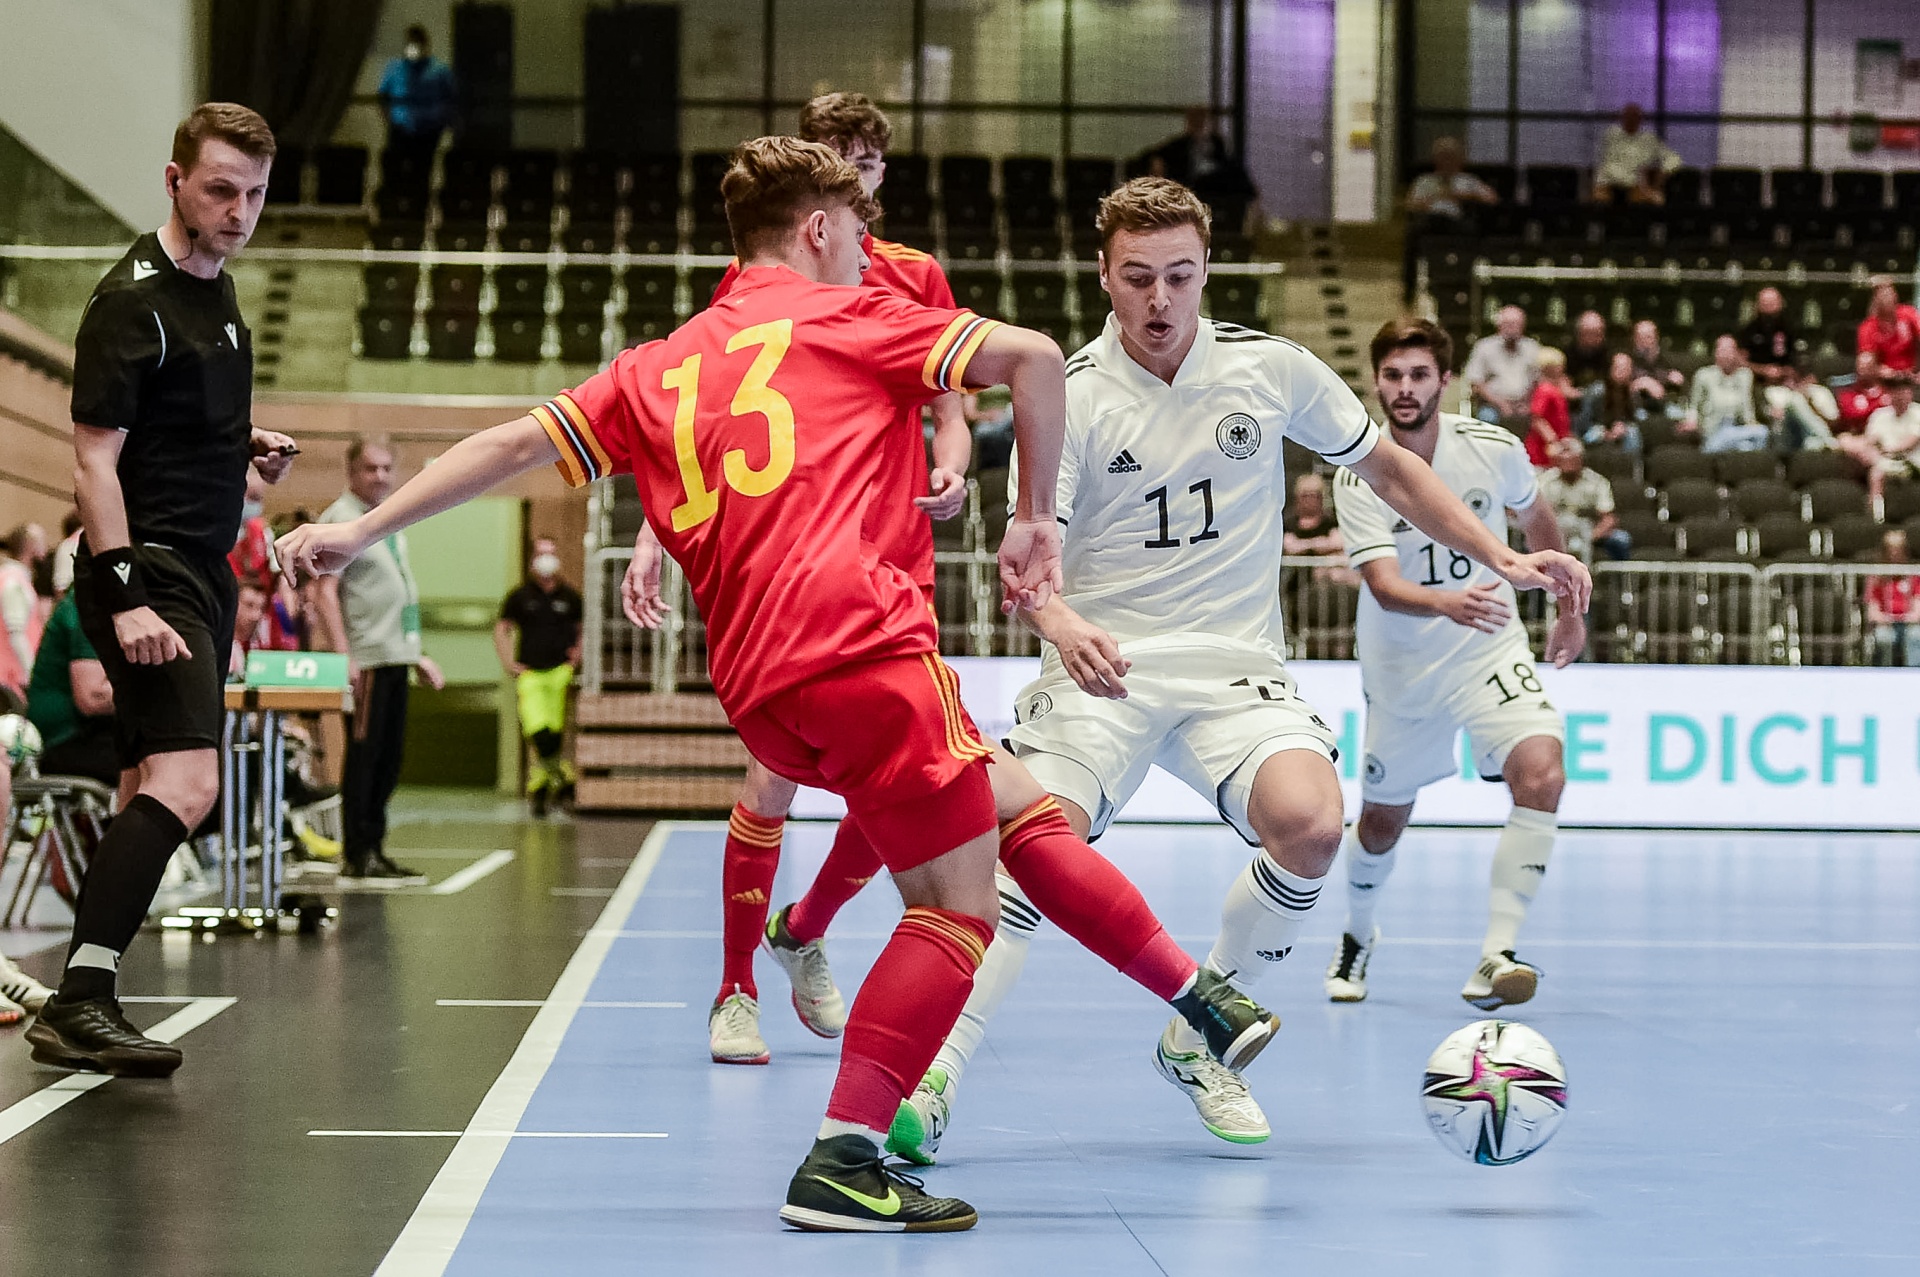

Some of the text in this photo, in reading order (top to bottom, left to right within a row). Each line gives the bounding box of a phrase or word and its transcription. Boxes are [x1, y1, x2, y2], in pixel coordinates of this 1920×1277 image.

[661, 317, 796, 533] 13
[1107, 463, 1142, 474] adidas
[1144, 478, 1219, 548] 11
[1418, 543, 1472, 586] 18
[285, 657, 318, 679] 5
[1486, 662, 1543, 706] 18
[1649, 713, 1879, 785] DICH
